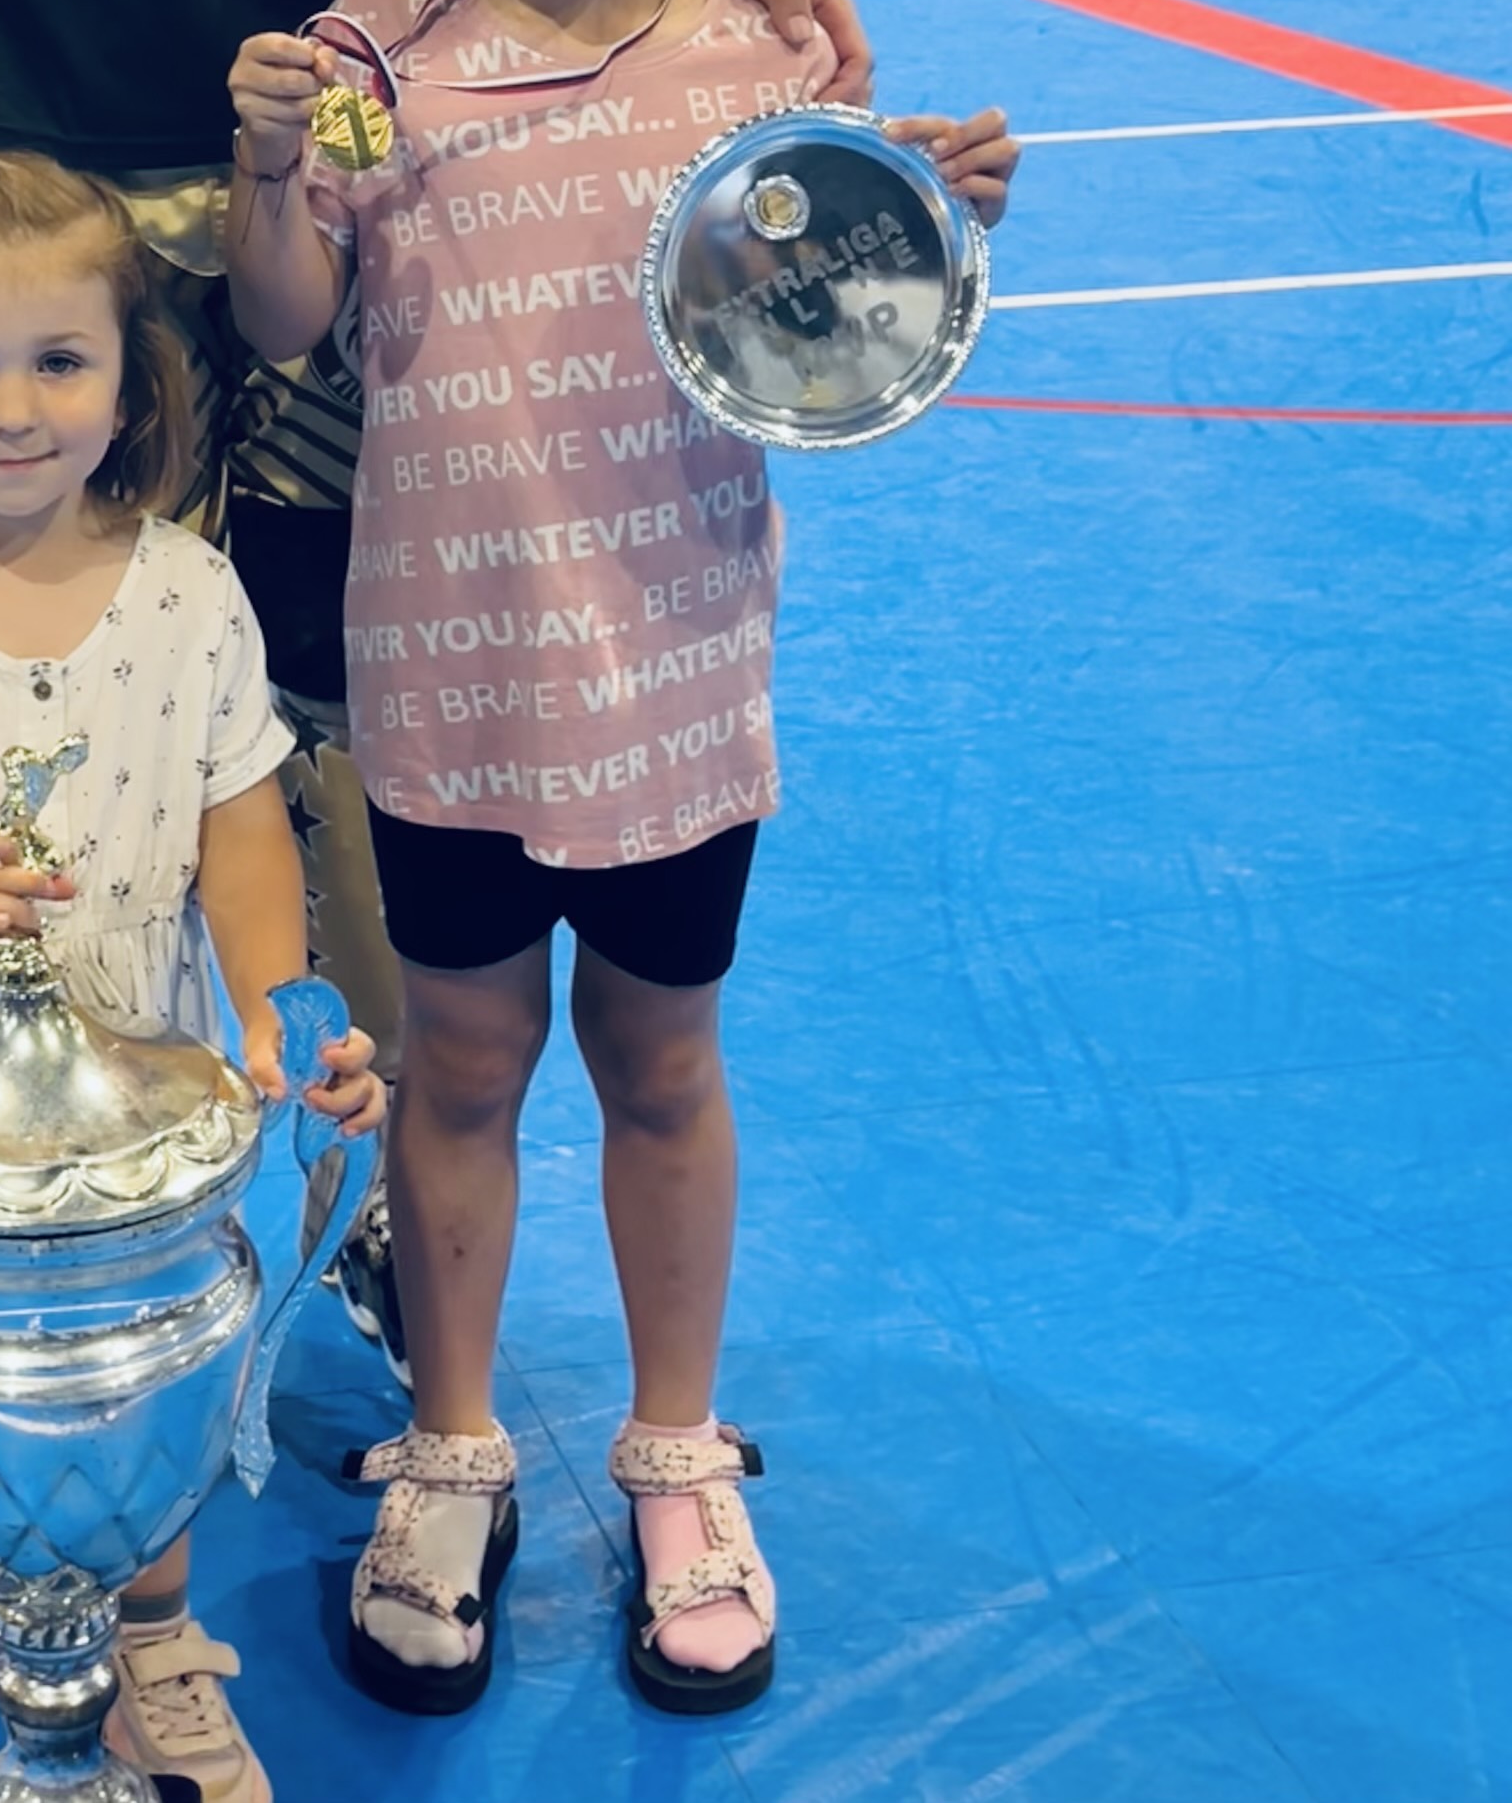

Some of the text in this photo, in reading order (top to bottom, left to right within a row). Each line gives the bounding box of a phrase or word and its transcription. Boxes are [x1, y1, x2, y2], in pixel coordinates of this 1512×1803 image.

[424, 111, 532, 166] YOU
[546, 96, 676, 145] SAY...
[685, 84, 743, 126] BE
[391, 203, 439, 248] BE
[448, 174, 605, 237] BRAVE
[365, 261, 644, 344] AVE WHATEV
[424, 364, 514, 416] YOU
[526, 350, 657, 400] SAY...
[392, 452, 436, 495] BE
[444, 430, 588, 487] BRAVE
[433, 501, 684, 576] WHATEVER
[688, 471, 765, 527] YOU
[414, 609, 516, 658] YOU
[643, 576, 692, 623] BE
[703, 545, 781, 603] BRAV
[380, 690, 426, 731] BE
[576, 610, 774, 714] WHATEVER
[427, 743, 651, 807] WHTEVER
[658, 708, 735, 768] YOU
[744, 690, 775, 736] SA
[618, 815, 665, 864] BE
